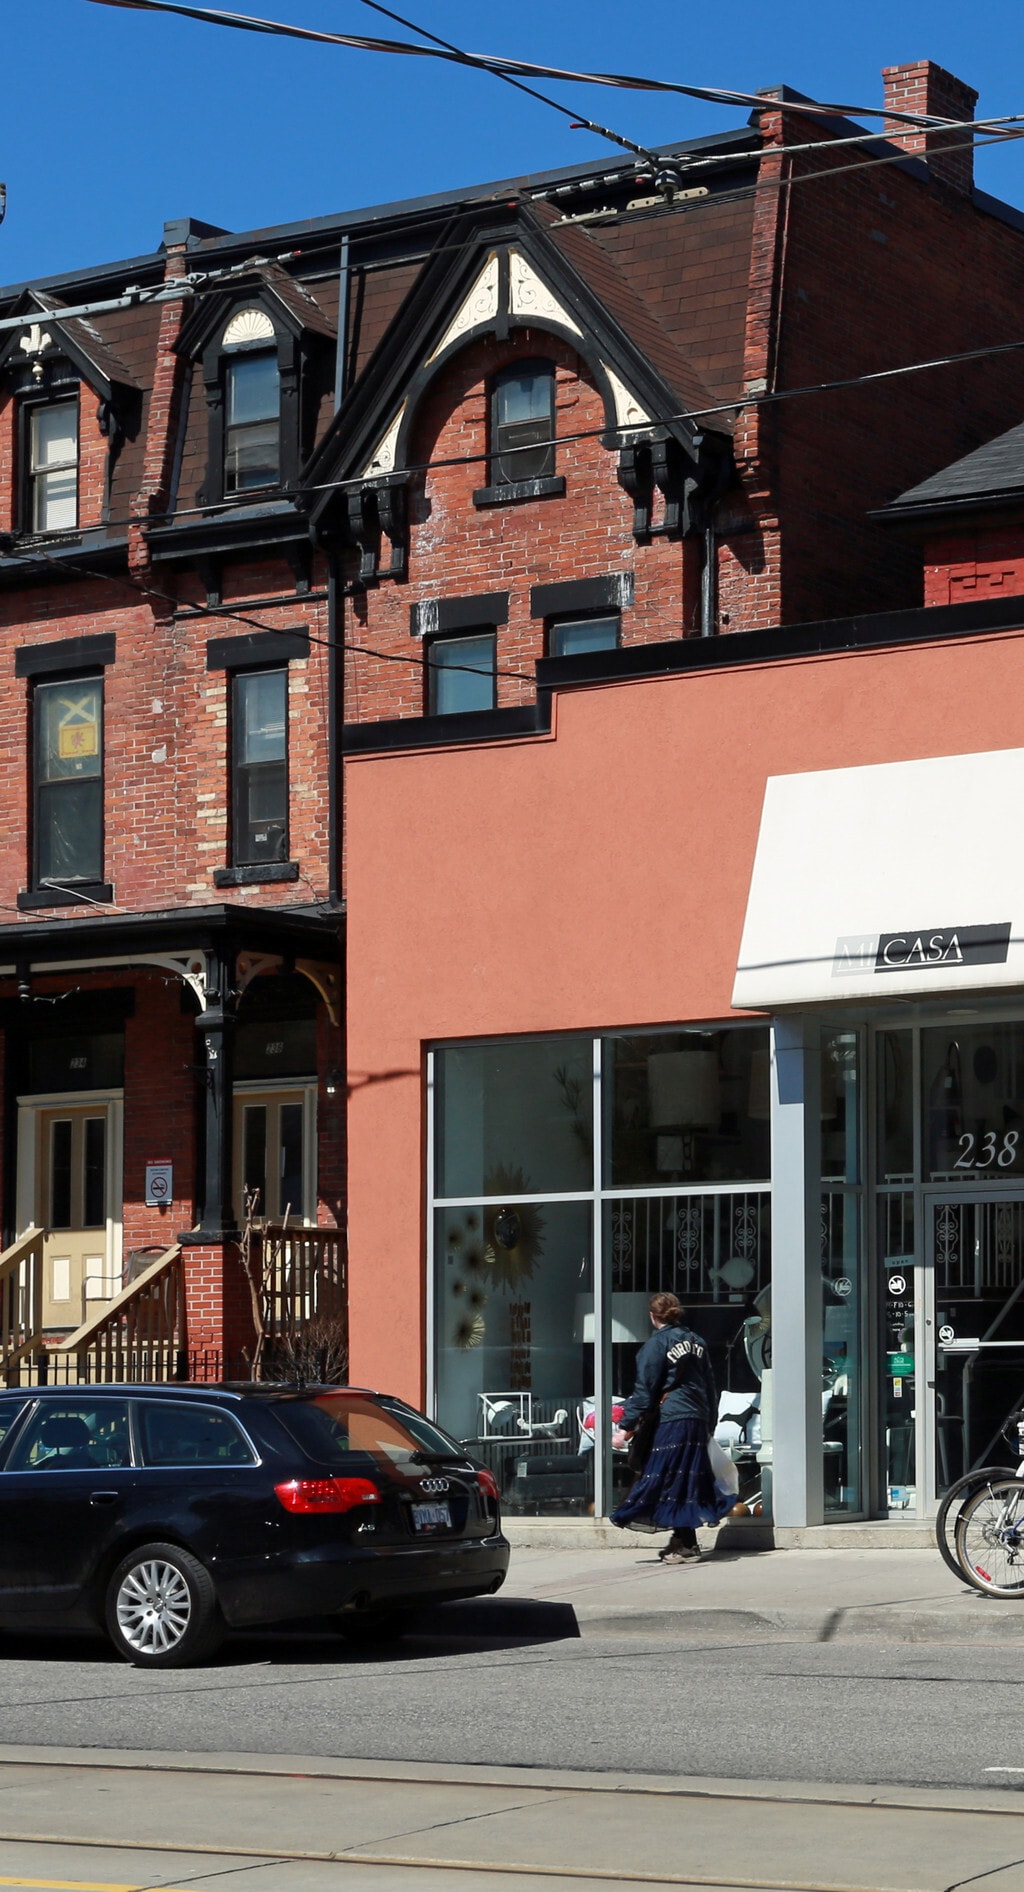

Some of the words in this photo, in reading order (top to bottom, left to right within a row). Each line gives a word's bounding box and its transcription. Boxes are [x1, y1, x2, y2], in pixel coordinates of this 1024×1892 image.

[838, 942, 874, 969] MI
[883, 933, 964, 965] CASA
[953, 1131, 1019, 1169] 238
